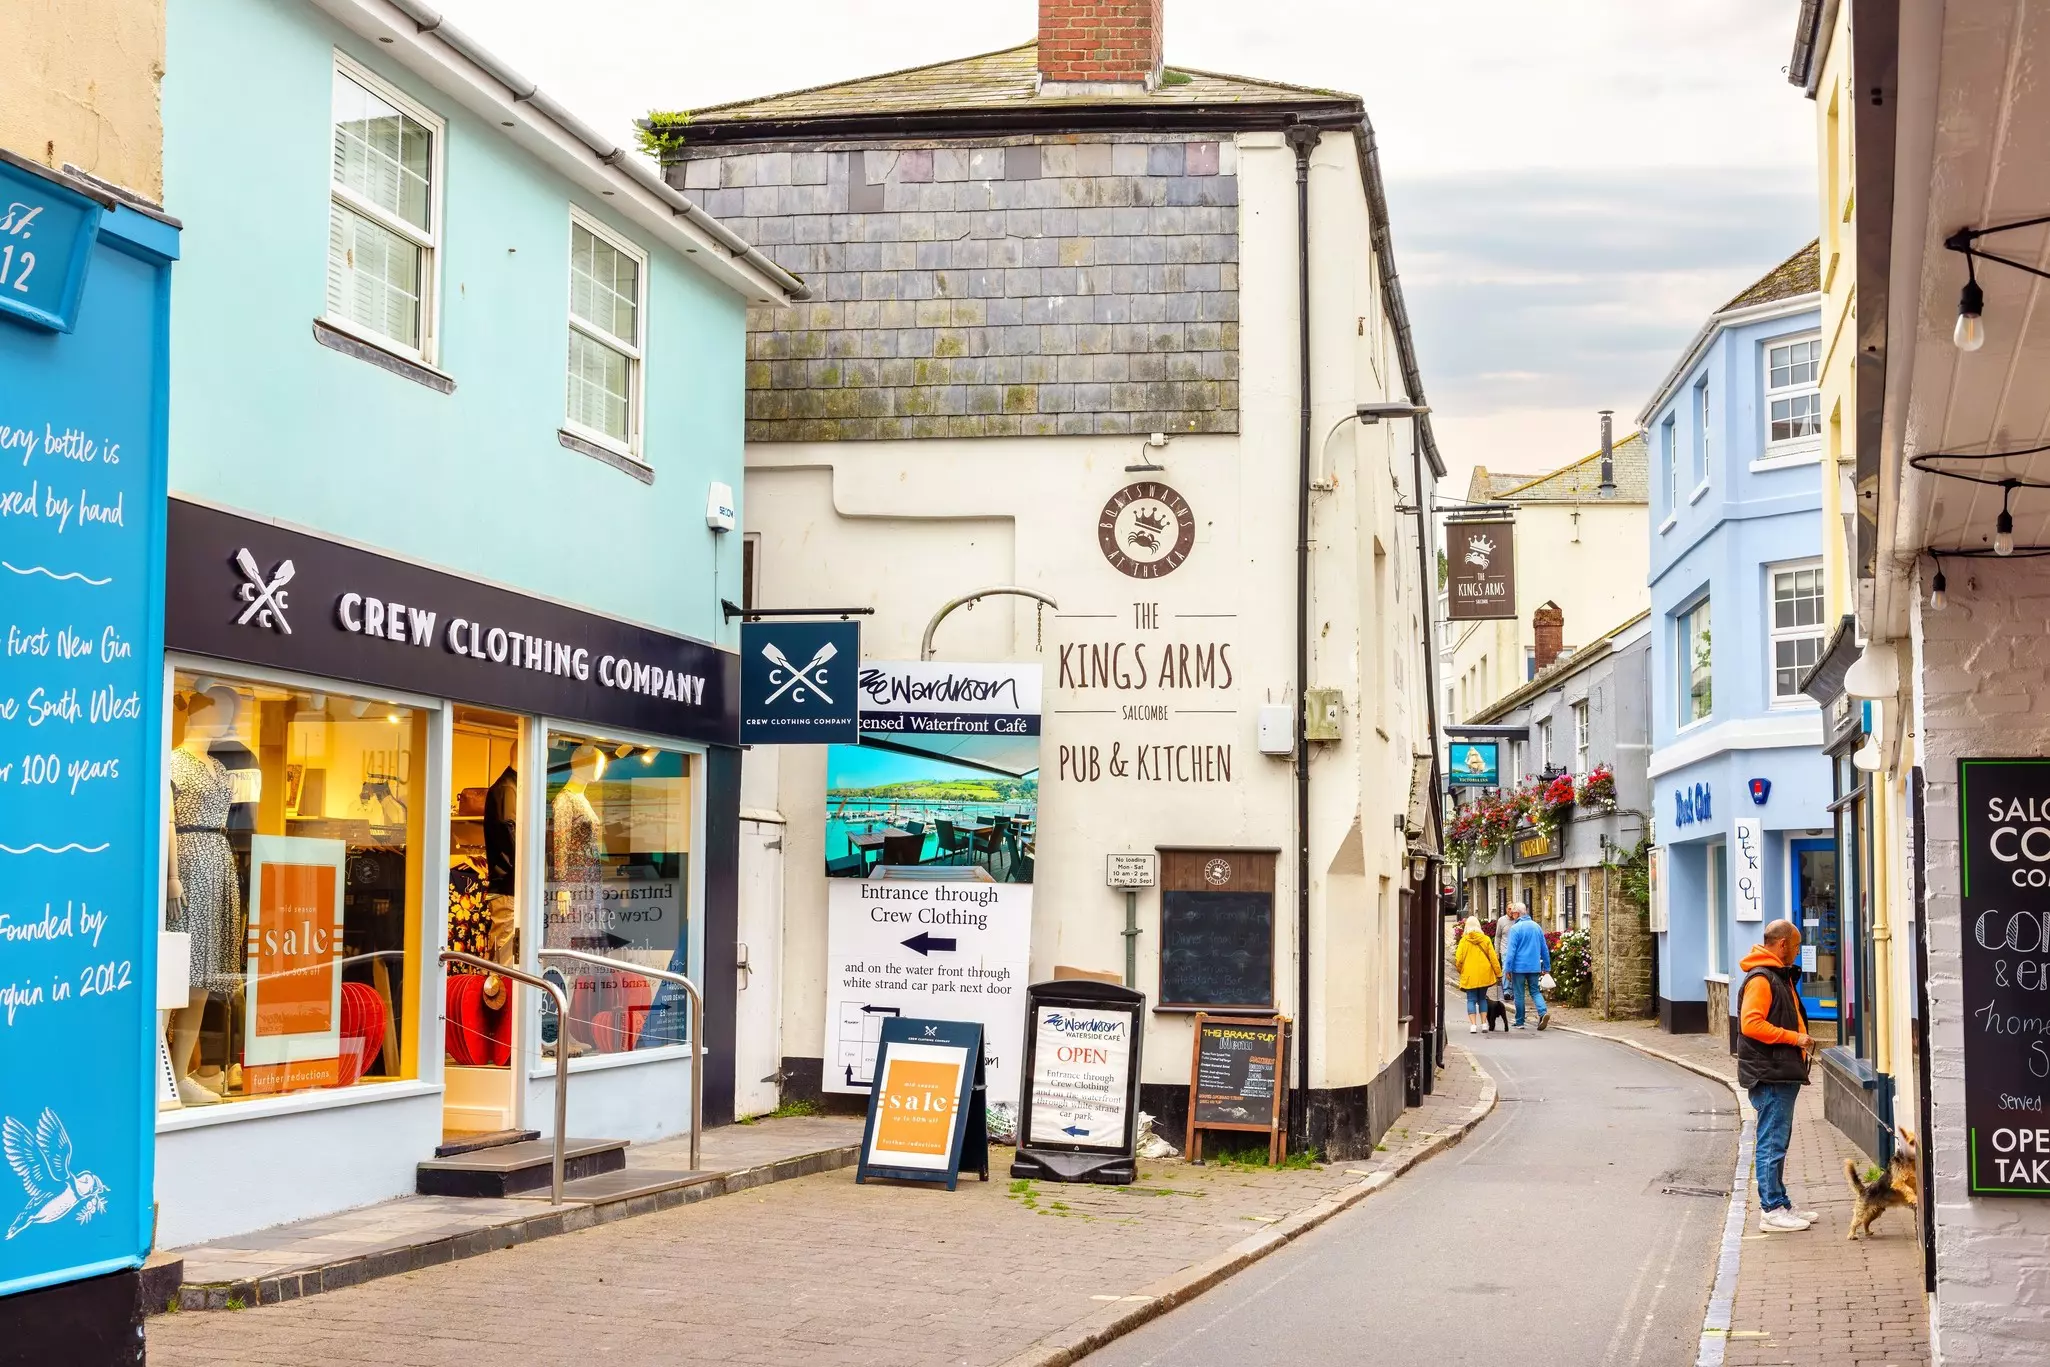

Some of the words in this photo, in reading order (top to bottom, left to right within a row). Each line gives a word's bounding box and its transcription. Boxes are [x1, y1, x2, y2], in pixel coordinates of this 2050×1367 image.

[0, 245, 36, 292] 12
[44, 422, 98, 462] bottle
[103, 438, 120, 464] is
[0, 479, 38, 517] xed
[45, 485, 74, 533] by
[79, 488, 124, 527] hand
[1099, 484, 1193, 529] BOATSWAINS
[1107, 550, 1126, 568] AT
[1133, 562, 1159, 578] THE
[1458, 583, 1483, 597] KINGS
[1485, 582, 1505, 596] ARMS
[1133, 603, 1159, 630] THE
[7, 625, 51, 656] first
[57, 625, 93, 659] New
[101, 625, 131, 663] Gin
[338, 592, 437, 648] CREW
[447, 618, 590, 681] CLOTHING
[598, 655, 706, 706] COMPANY
[1059, 642, 1148, 690] KINGS
[1158, 642, 1233, 690] ARMS
[891, 673, 1020, 710] Wardroom
[27, 687, 82, 726] South
[90, 684, 141, 724] West
[1122, 704, 1169, 721] SALCOMBE
[746, 718, 769, 726] CREW
[770, 718, 812, 726] CLOTHING
[813, 717, 853, 726] COMPANY
[910, 716, 990, 733] Waterfront
[994, 718, 1028, 733] Café
[21, 753, 60, 785] 100
[67, 758, 120, 796] years
[1060, 744, 1101, 783] PUB
[1109, 741, 1129, 778] &
[1137, 743, 1232, 783] KITCHEN
[1737, 826, 1758, 869] DECK
[2012, 869, 2050, 887] CO
[861, 883, 929, 901] Entrance
[935, 885, 999, 908] through
[1739, 877, 1760, 909] OUT
[294, 906, 317, 914] season
[577, 903, 616, 931] Take
[870, 907, 912, 924] Crew
[918, 908, 988, 931] Clothing
[0, 900, 73, 941] Founded
[80, 902, 108, 948] by
[265, 920, 329, 957] sale
[52, 975, 71, 1001] in
[80, 960, 132, 997] 2012
[845, 961, 864, 973] and
[868, 964, 881, 974] on
[885, 962, 902, 974] the
[905, 965, 934, 977] water
[937, 963, 964, 978] front
[968, 966, 1011, 980] through
[1995, 959, 2010, 988] &
[843, 977, 871, 989] white
[875, 978, 908, 990] strand
[911, 981, 928, 991] car
[931, 980, 956, 995] park
[960, 982, 983, 994] next
[986, 984, 1012, 995] door
[1066, 1031, 1102, 1040] WATERSIDE
[1103, 1034, 1121, 1042] CAFÉ
[1202, 1028, 1222, 1038] THE
[1223, 1029, 1256, 1040] BRAAI
[1218, 1037, 1253, 1050] Menu
[1057, 1046, 1108, 1065] OPEN
[253, 1073, 284, 1086] further
[287, 1070, 330, 1082] reductions
[1047, 1069, 1081, 1080] Entrance
[1083, 1072, 1115, 1083] through
[1051, 1079, 1073, 1088] Crew
[1074, 1081, 1109, 1093] Clothing
[889, 1091, 949, 1113] sale
[1095, 1105, 1119, 1114] strand
[1992, 1128, 2050, 1153] OPE
[1994, 1158, 2050, 1184] TAK
